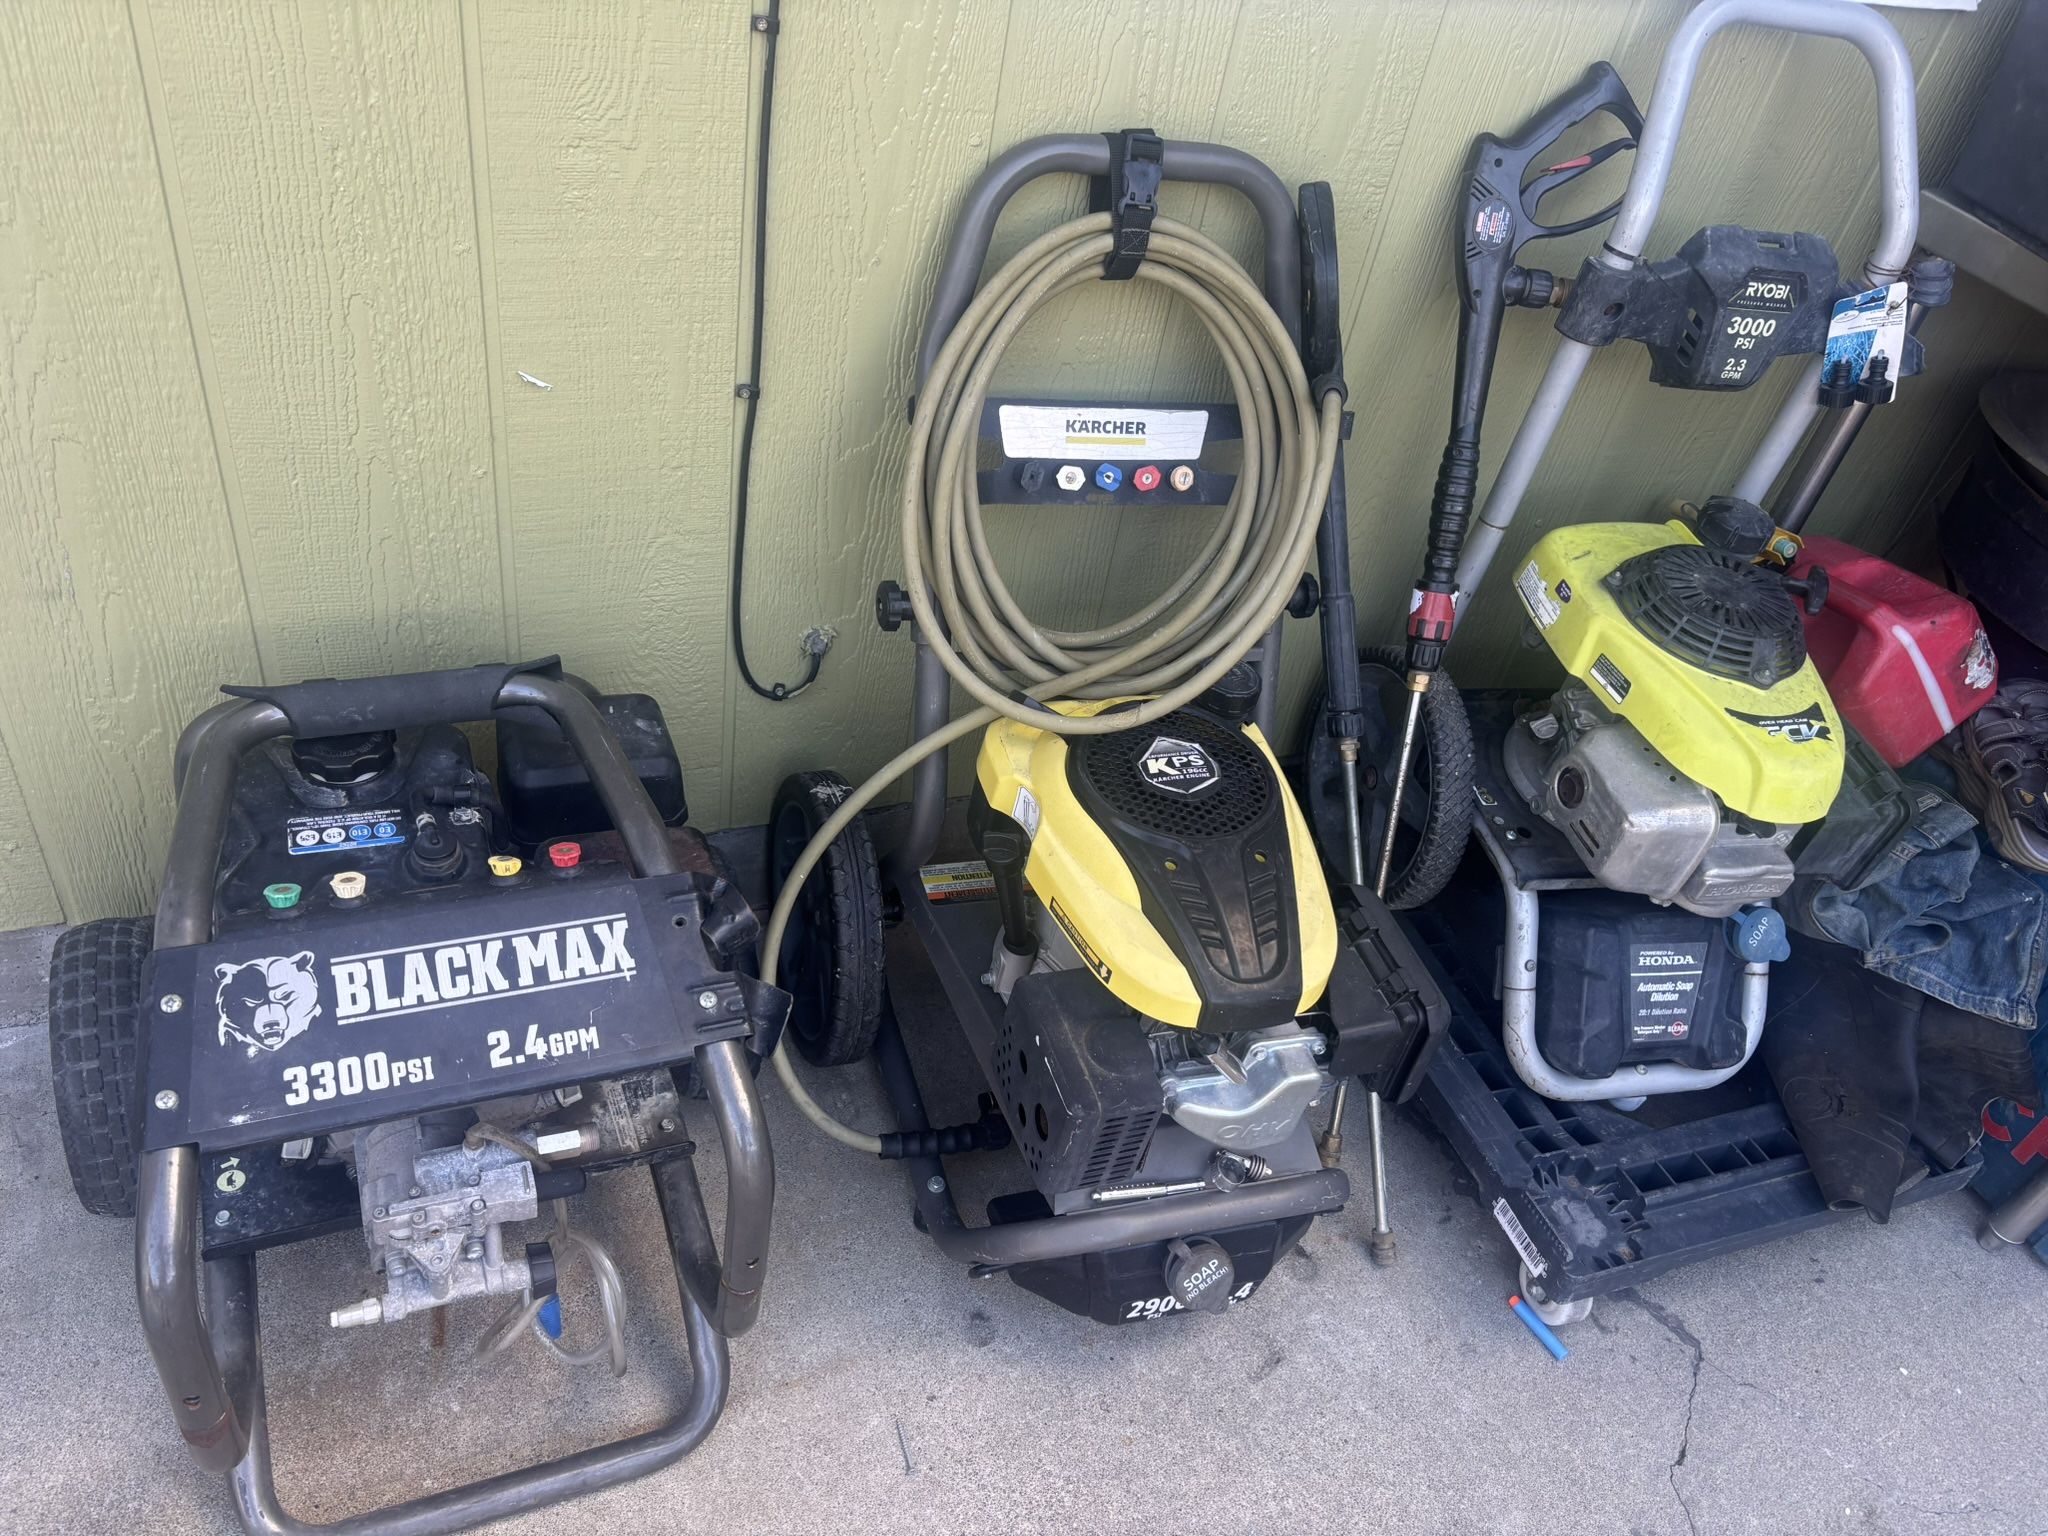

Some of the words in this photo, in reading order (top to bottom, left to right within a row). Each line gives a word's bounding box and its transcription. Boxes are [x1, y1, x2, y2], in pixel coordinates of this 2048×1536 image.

[1745, 282, 1790, 300] RYOBI
[1727, 316, 1776, 337] 3000
[1734, 337, 1755, 350] PSI
[1724, 358, 1747, 372] 2.3
[1721, 371, 1742, 380] GPM
[1065, 419, 1146, 435] KÄRCHER
[1146, 755, 1205, 775] KPS
[325, 831, 342, 840] E15
[352, 828, 369, 836] E10
[378, 826, 391, 834] E0
[1705, 883, 1781, 897] HONDA
[1748, 916, 1769, 947] SOAP
[1638, 955, 1697, 966] HONDA
[331, 939, 510, 1018] BLACK
[512, 920, 636, 986] MAX
[1637, 981, 1676, 992] Automatic
[1676, 981, 1694, 992] Soap
[1650, 991, 1679, 1002] Dilution
[1638, 1008, 1651, 1017] 20:1
[1651, 1008, 1673, 1016] Dilution
[1673, 1007, 1687, 1015] Ratio
[1183, 1259, 1219, 1292] SOAP
[1186, 1288, 1199, 1302] (NO
[1199, 1266, 1229, 1292] BLEACH)
[1147, 1312, 1162, 1320] PSI
